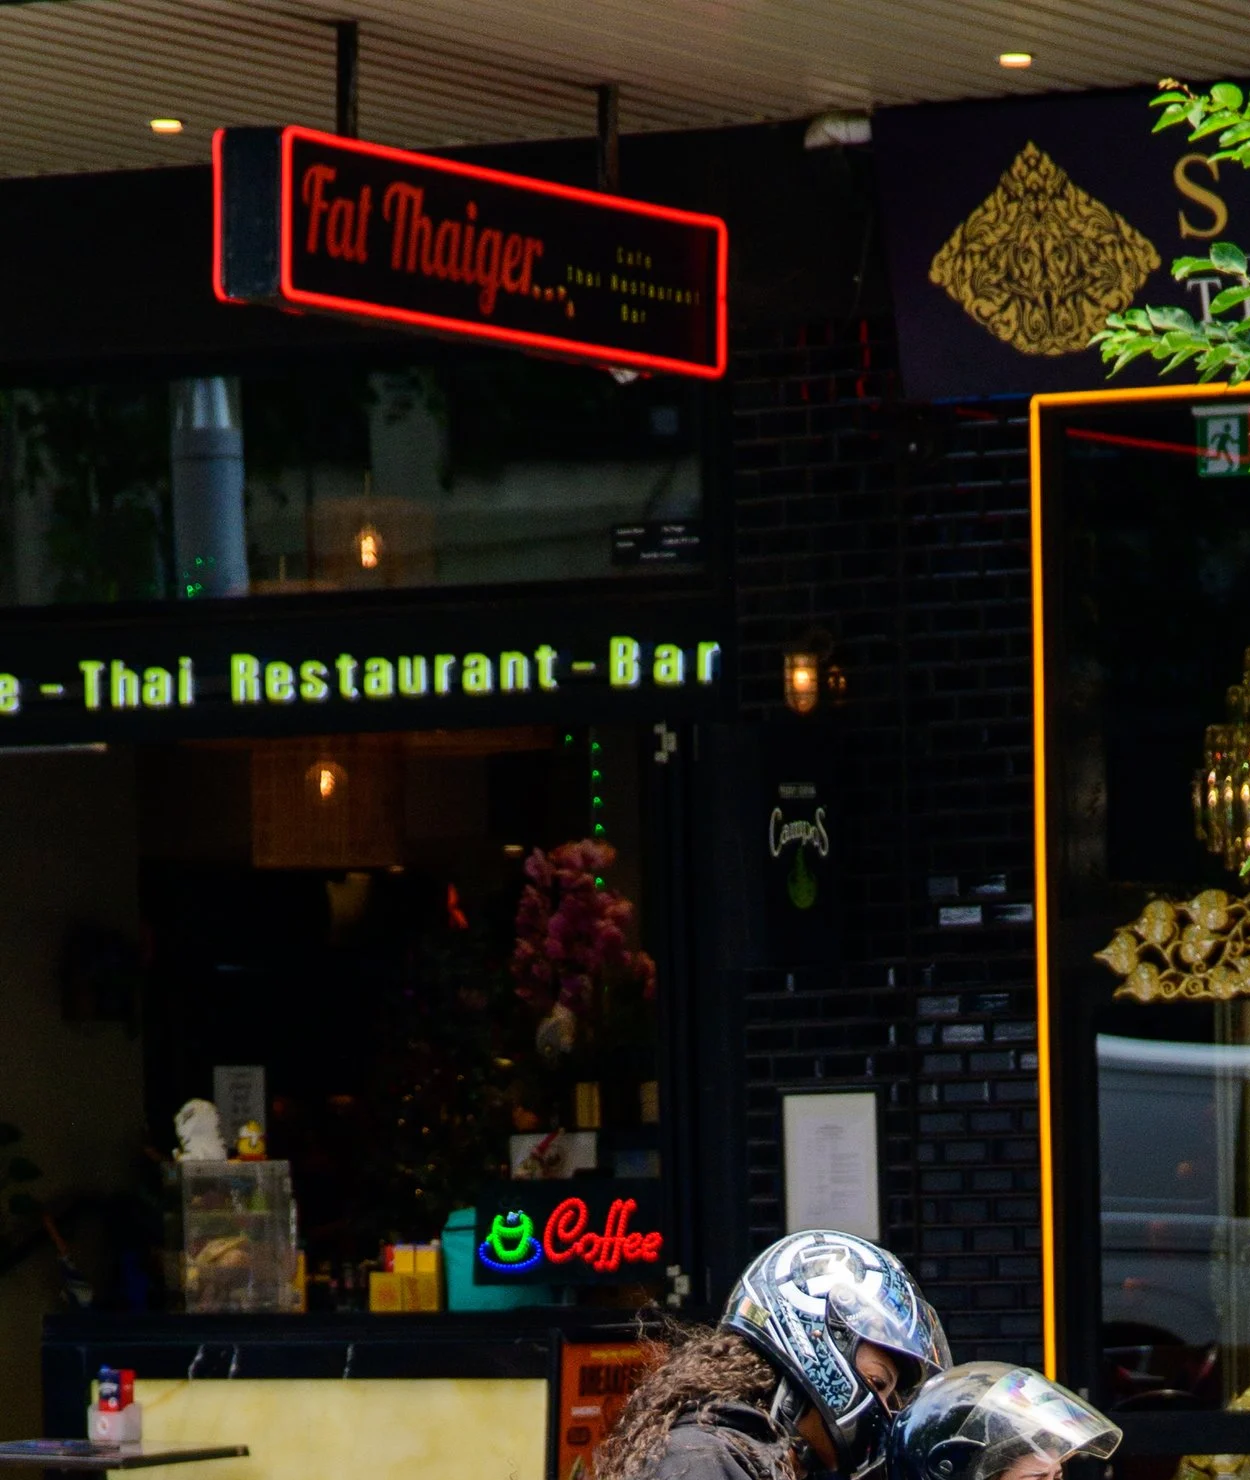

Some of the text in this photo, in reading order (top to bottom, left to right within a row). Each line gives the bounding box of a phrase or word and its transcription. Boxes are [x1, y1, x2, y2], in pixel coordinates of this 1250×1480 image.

[301, 163, 373, 264] Fat
[79, 656, 194, 709] Thai
[229, 644, 559, 704] Restaurant
[608, 637, 720, 686] Bar
[543, 1196, 664, 1272] Coffee
